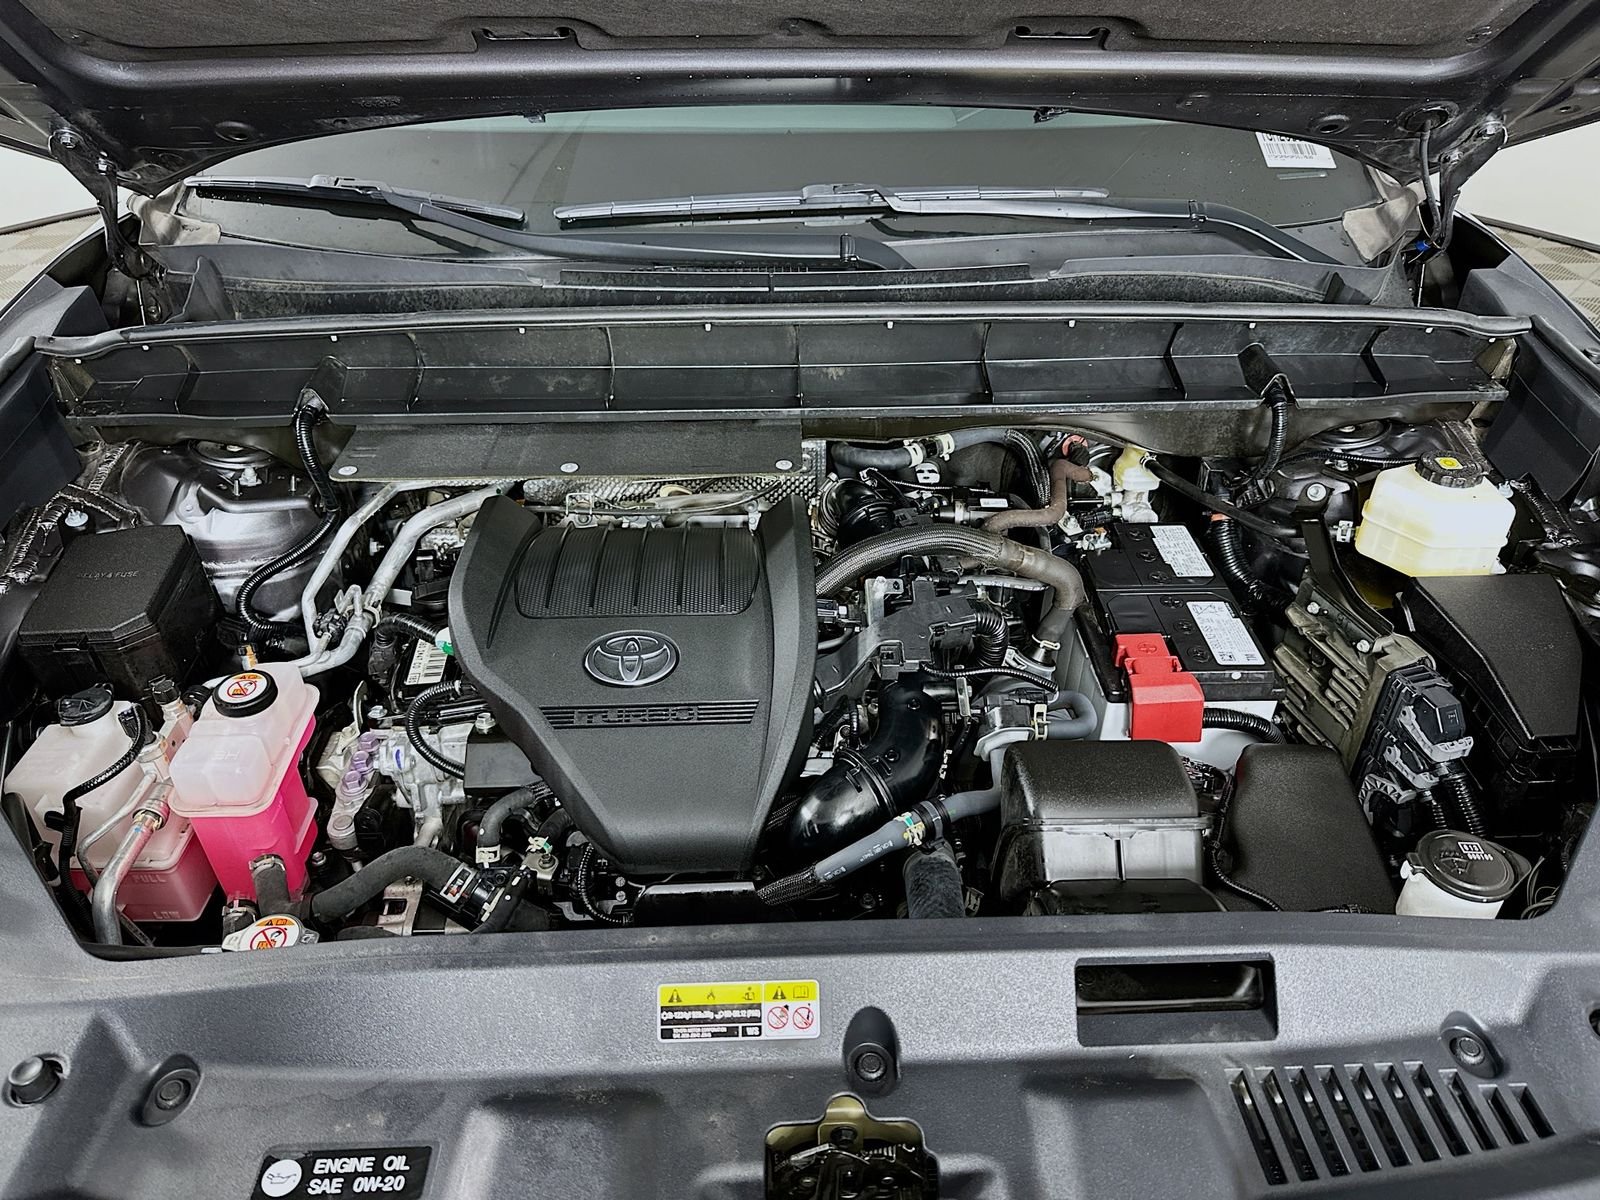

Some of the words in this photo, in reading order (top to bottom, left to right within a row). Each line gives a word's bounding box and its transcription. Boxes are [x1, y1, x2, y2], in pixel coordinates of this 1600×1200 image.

[115, 570, 139, 578] FUSE
[577, 706, 694, 723] TURBO
[132, 874, 167, 883] FULL
[153, 911, 181, 920] LOW
[312, 1156, 376, 1174] ENGINE
[382, 1155, 410, 1171] OIL
[307, 1177, 344, 1195] SAE
[352, 1175, 406, 1193] 0W-20
